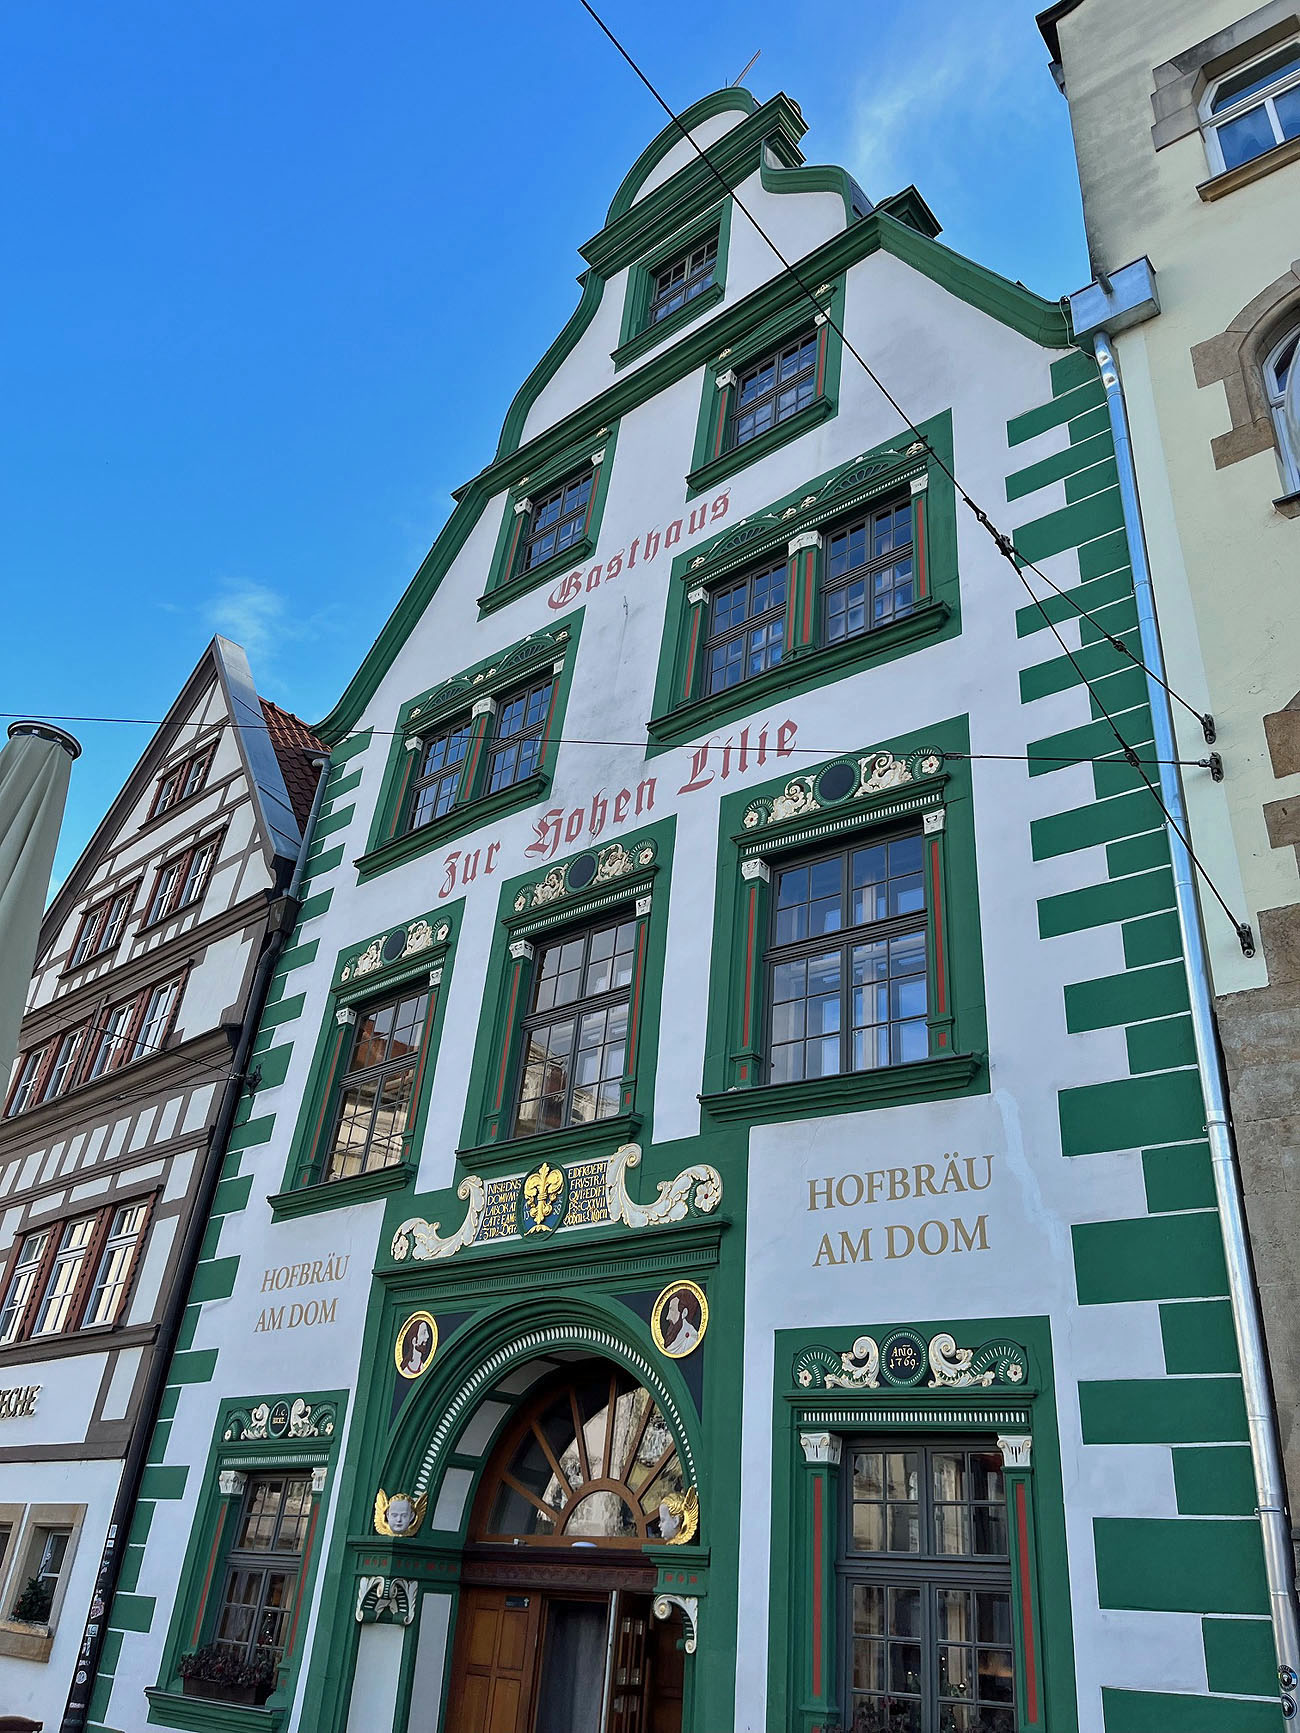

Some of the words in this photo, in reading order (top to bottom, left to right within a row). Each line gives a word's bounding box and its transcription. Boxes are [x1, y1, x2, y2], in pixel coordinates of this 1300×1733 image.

[548, 487, 731, 609] Gasthaus
[438, 839, 501, 899] Zur
[524, 776, 658, 862] Hohen
[676, 719, 799, 797] Lilie
[806, 1151, 995, 1211] HOFBRÄU
[812, 1228, 873, 1267] AM
[884, 1214, 991, 1260] DOM
[260, 1252, 351, 1293] HOFBRÄU
[253, 1306, 286, 1333] AM
[287, 1297, 339, 1329] DOM
[0, 1385, 41, 1418] ECHE
